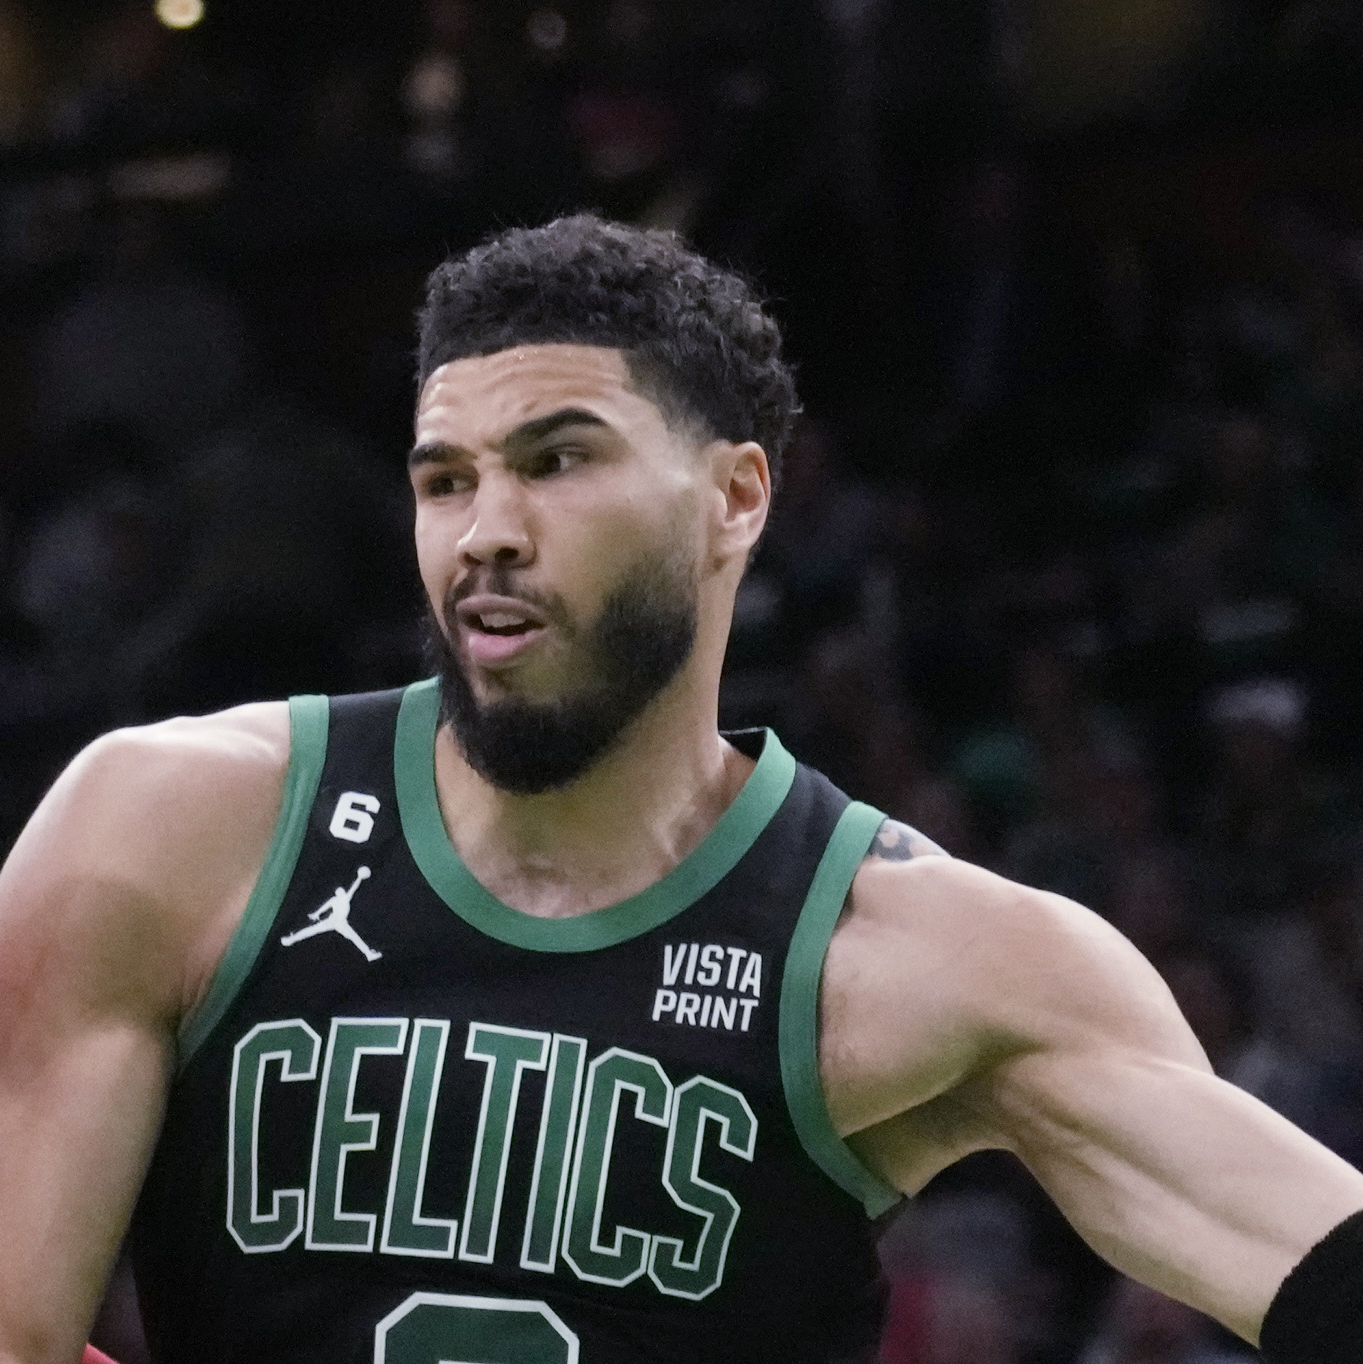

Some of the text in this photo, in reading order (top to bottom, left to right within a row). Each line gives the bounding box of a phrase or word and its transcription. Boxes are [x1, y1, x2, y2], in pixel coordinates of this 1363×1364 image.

[328, 790, 381, 844] 6
[662, 942, 762, 998] VISTA
[652, 988, 759, 1032] PRINT
[226, 1017, 759, 1301] CELTICS
